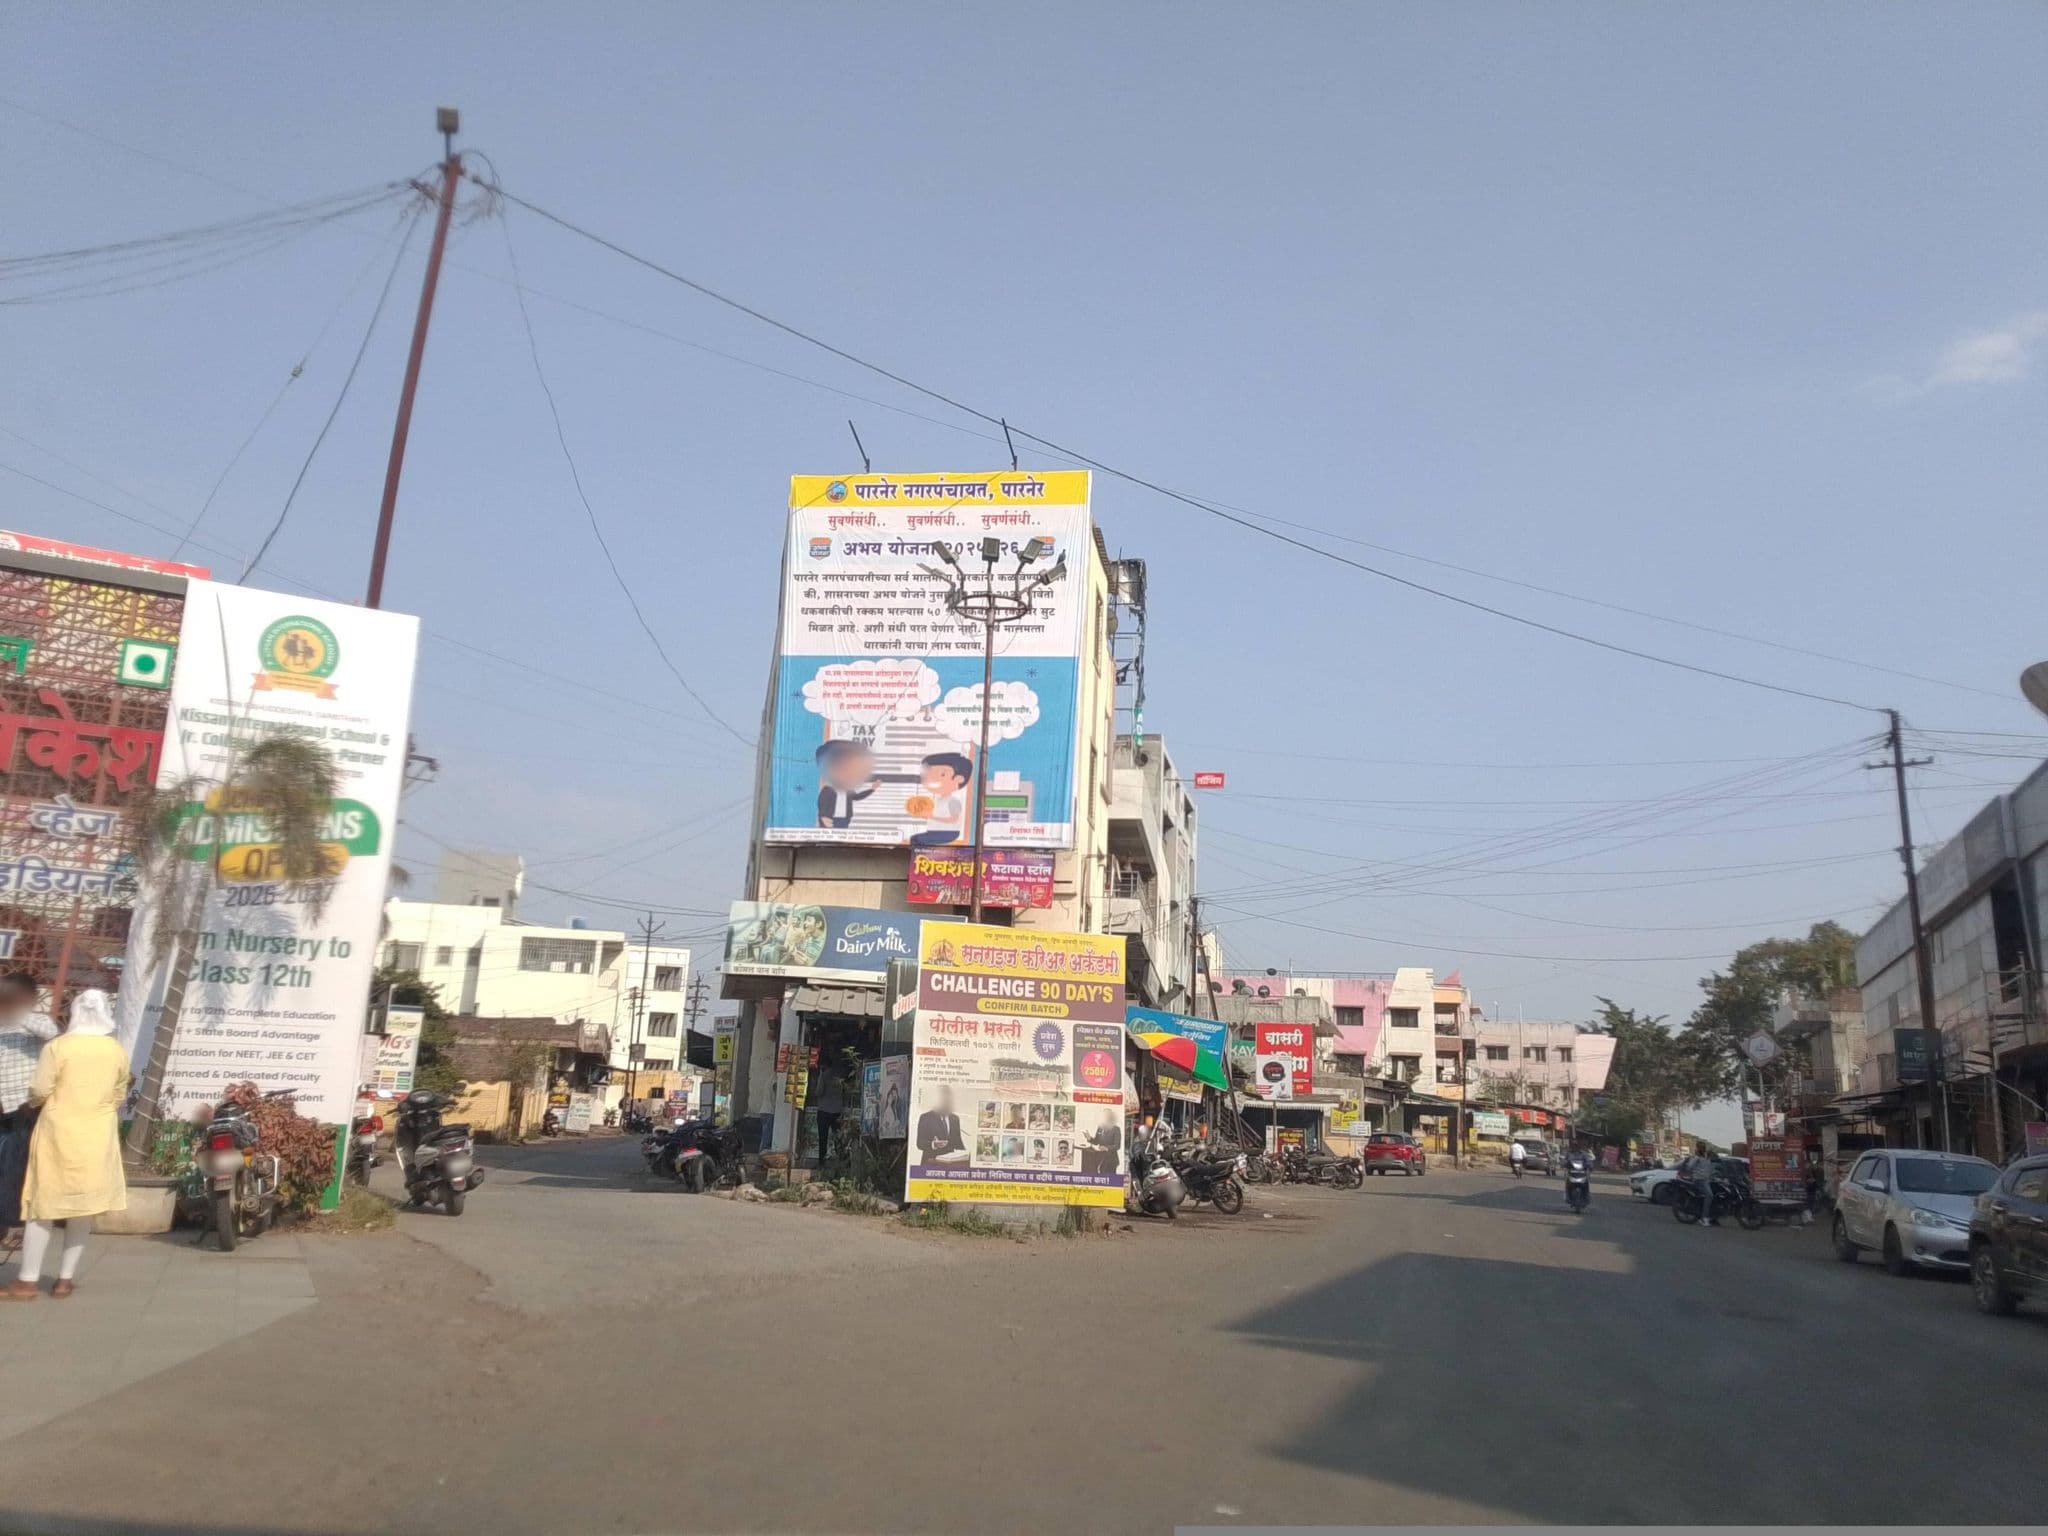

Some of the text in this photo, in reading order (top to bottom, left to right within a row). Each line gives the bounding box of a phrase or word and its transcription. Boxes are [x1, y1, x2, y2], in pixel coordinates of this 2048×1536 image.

[855, 476, 1045, 500] पारनेर नगरपंचायत, पारनेर
[843, 541, 883, 556] अभय
[793, 571, 819, 583] पारनेर
[894, 571, 909, 583] सर्व
[824, 589, 869, 599] शासनाच्या
[873, 589, 897, 599] अभय
[900, 587, 926, 599] योजने
[808, 621, 833, 632] मिळत
[864, 621, 885, 633] अशी
[888, 621, 906, 632] संधी
[910, 624, 927, 633] परत
[905, 641, 928, 651] याचा
[852, 725, 877, 736] TAX
[31, 794, 120, 838] व्हेज
[991, 863, 1053, 876] फटाका स्टॉल
[225, 927, 322, 961] Nursery
[329, 935, 352, 958] to
[836, 934, 911, 956] Dairy Milk
[259, 963, 312, 988] 12th
[930, 972, 1114, 1003] CHALLENGE 90 DAY'S
[190, 1006, 202, 1015] to
[227, 1008, 281, 1022] Complete
[283, 1010, 336, 1021] Education
[984, 1000, 1062, 1014] CONFIRM BATCH
[194, 1026, 224, 1037] State
[226, 1028, 258, 1039] Board
[261, 1030, 320, 1043] Advantage
[929, 1014, 1022, 1040] पोलीस भरती
[219, 1048, 234, 1059] for
[236, 1050, 263, 1061] NEET,
[266, 1051, 283, 1060] JEE
[285, 1052, 294, 1060] &
[296, 1052, 316, 1061] CET
[212, 1069, 220, 1079] &
[223, 1069, 278, 1081] Dedicated
[281, 1072, 321, 1083] Faculty
